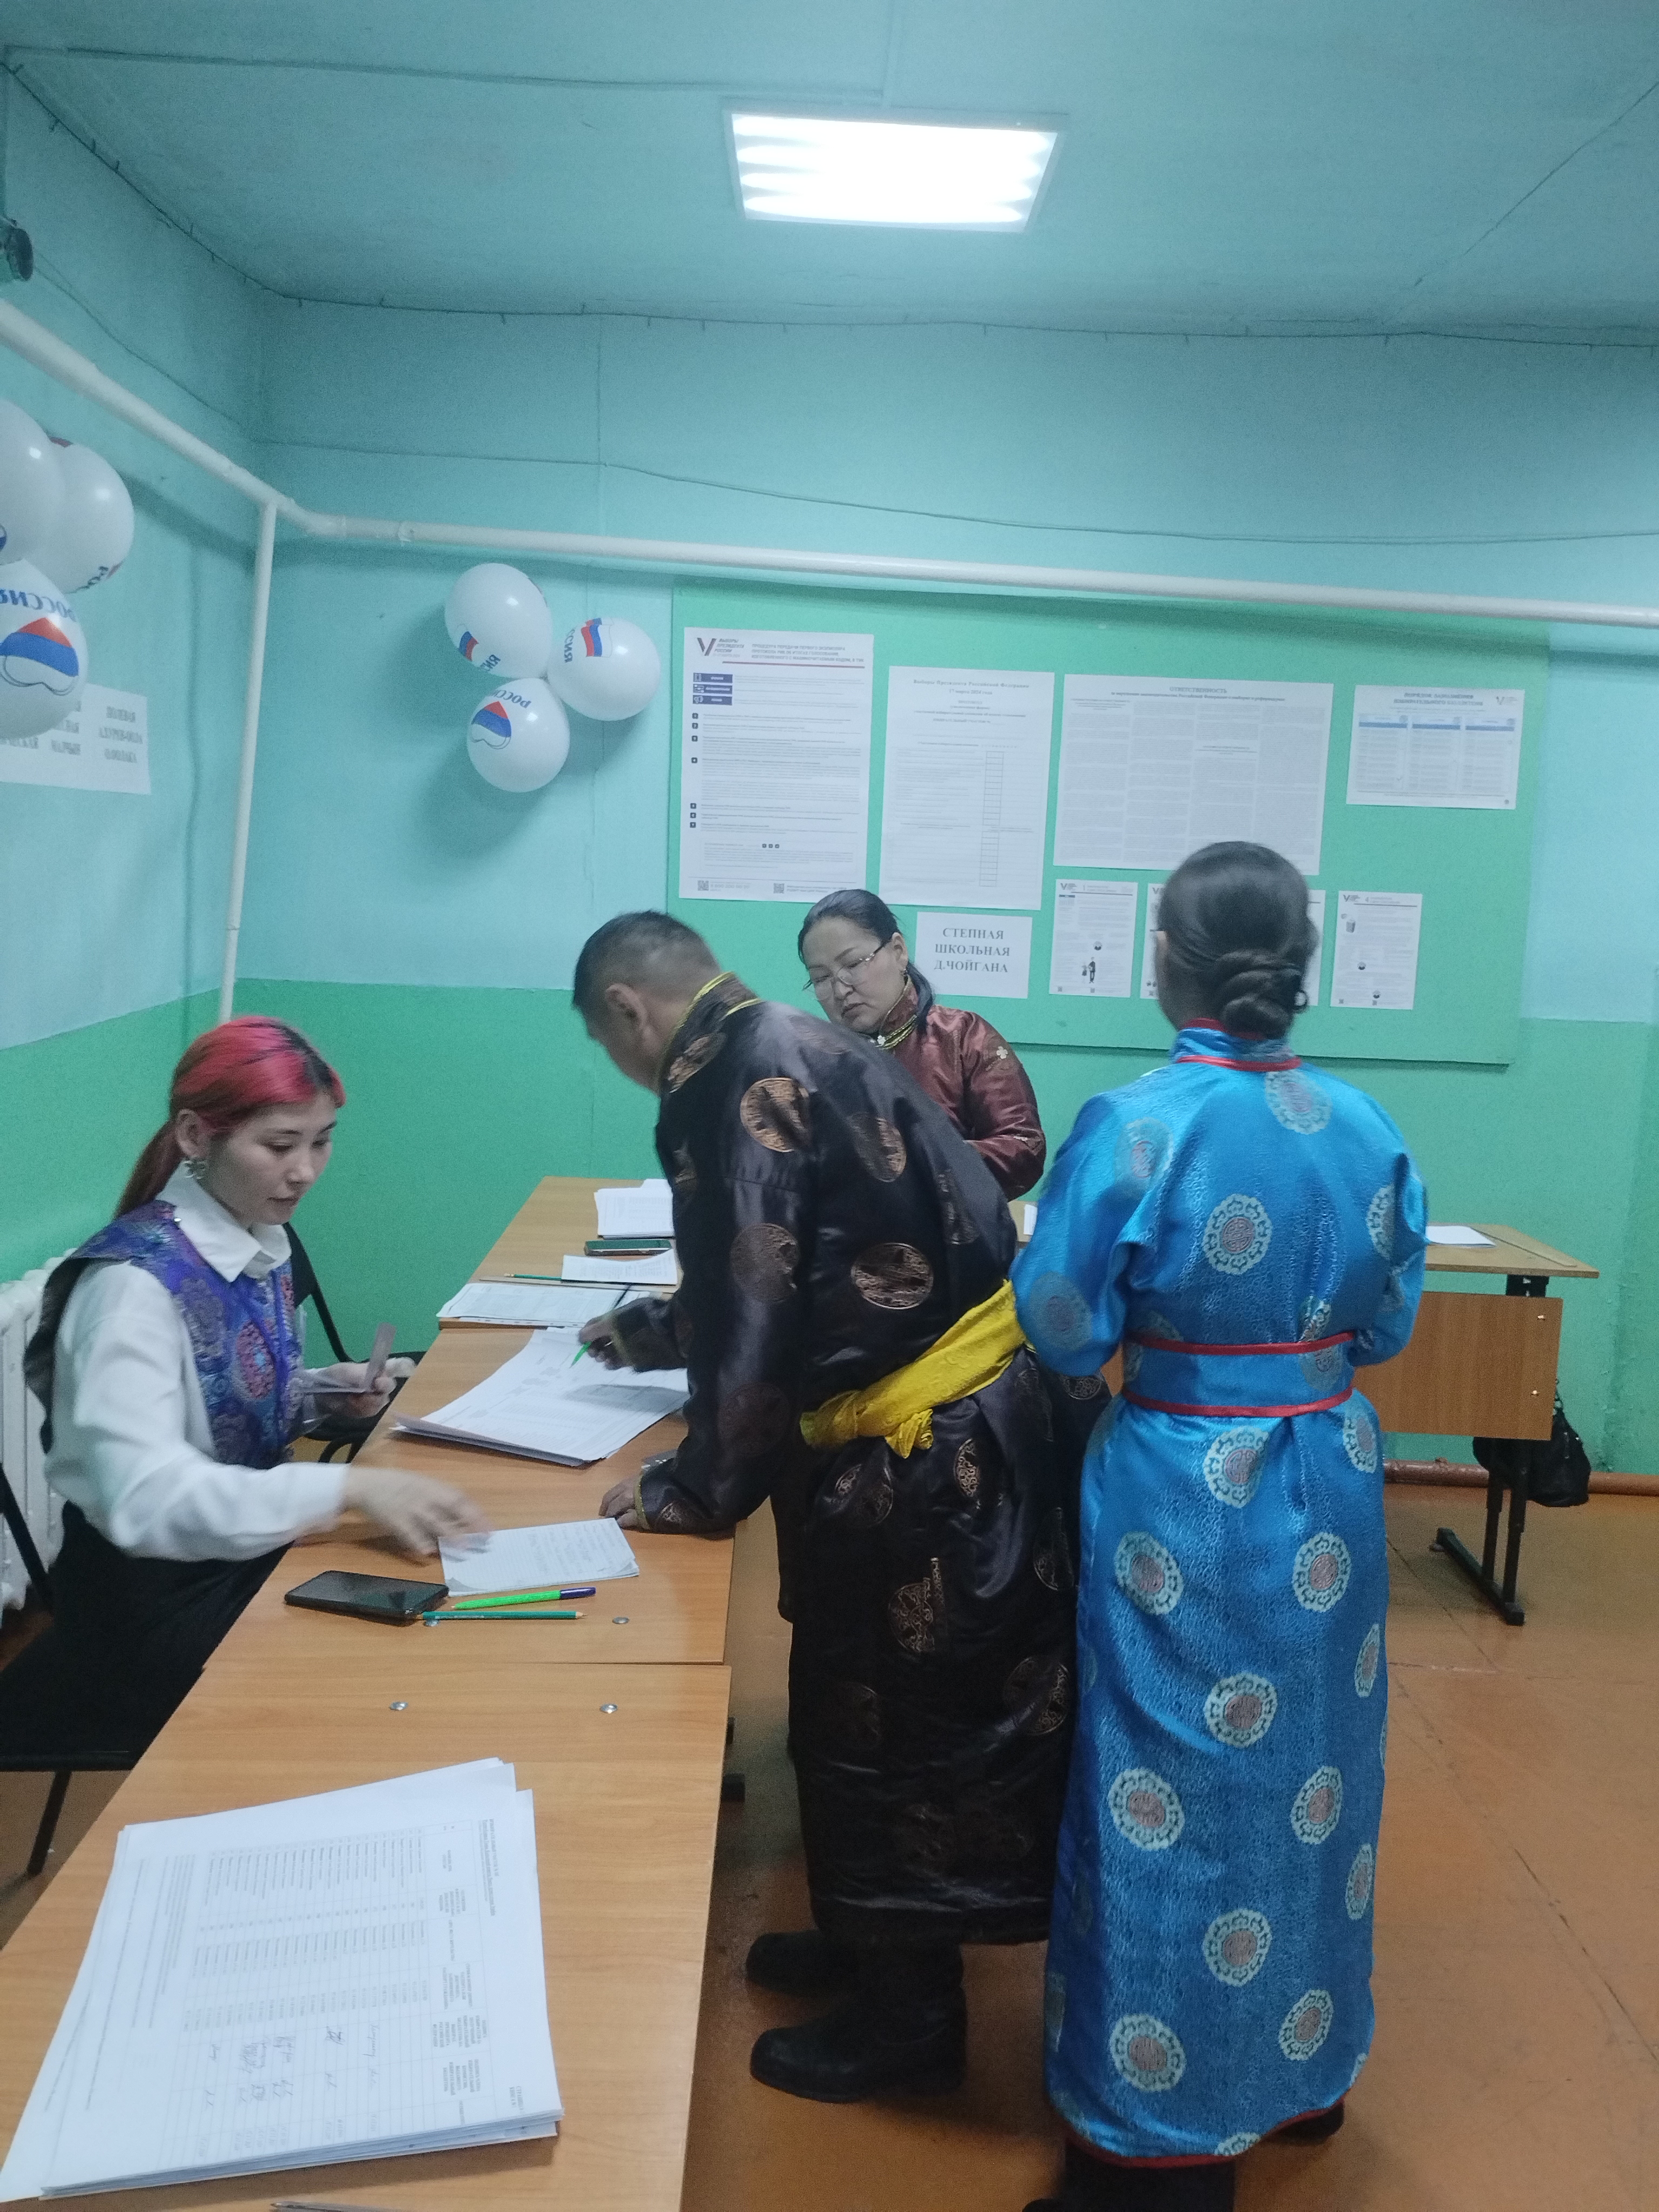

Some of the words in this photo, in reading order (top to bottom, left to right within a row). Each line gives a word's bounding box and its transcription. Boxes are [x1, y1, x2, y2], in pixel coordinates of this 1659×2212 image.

[942, 928, 1004, 940] СТЕПНАЯ
[935, 943, 1010, 956] ШКОЛЬНАЯ
[934, 959, 1008, 973] Д.ЧОЙГАНА
